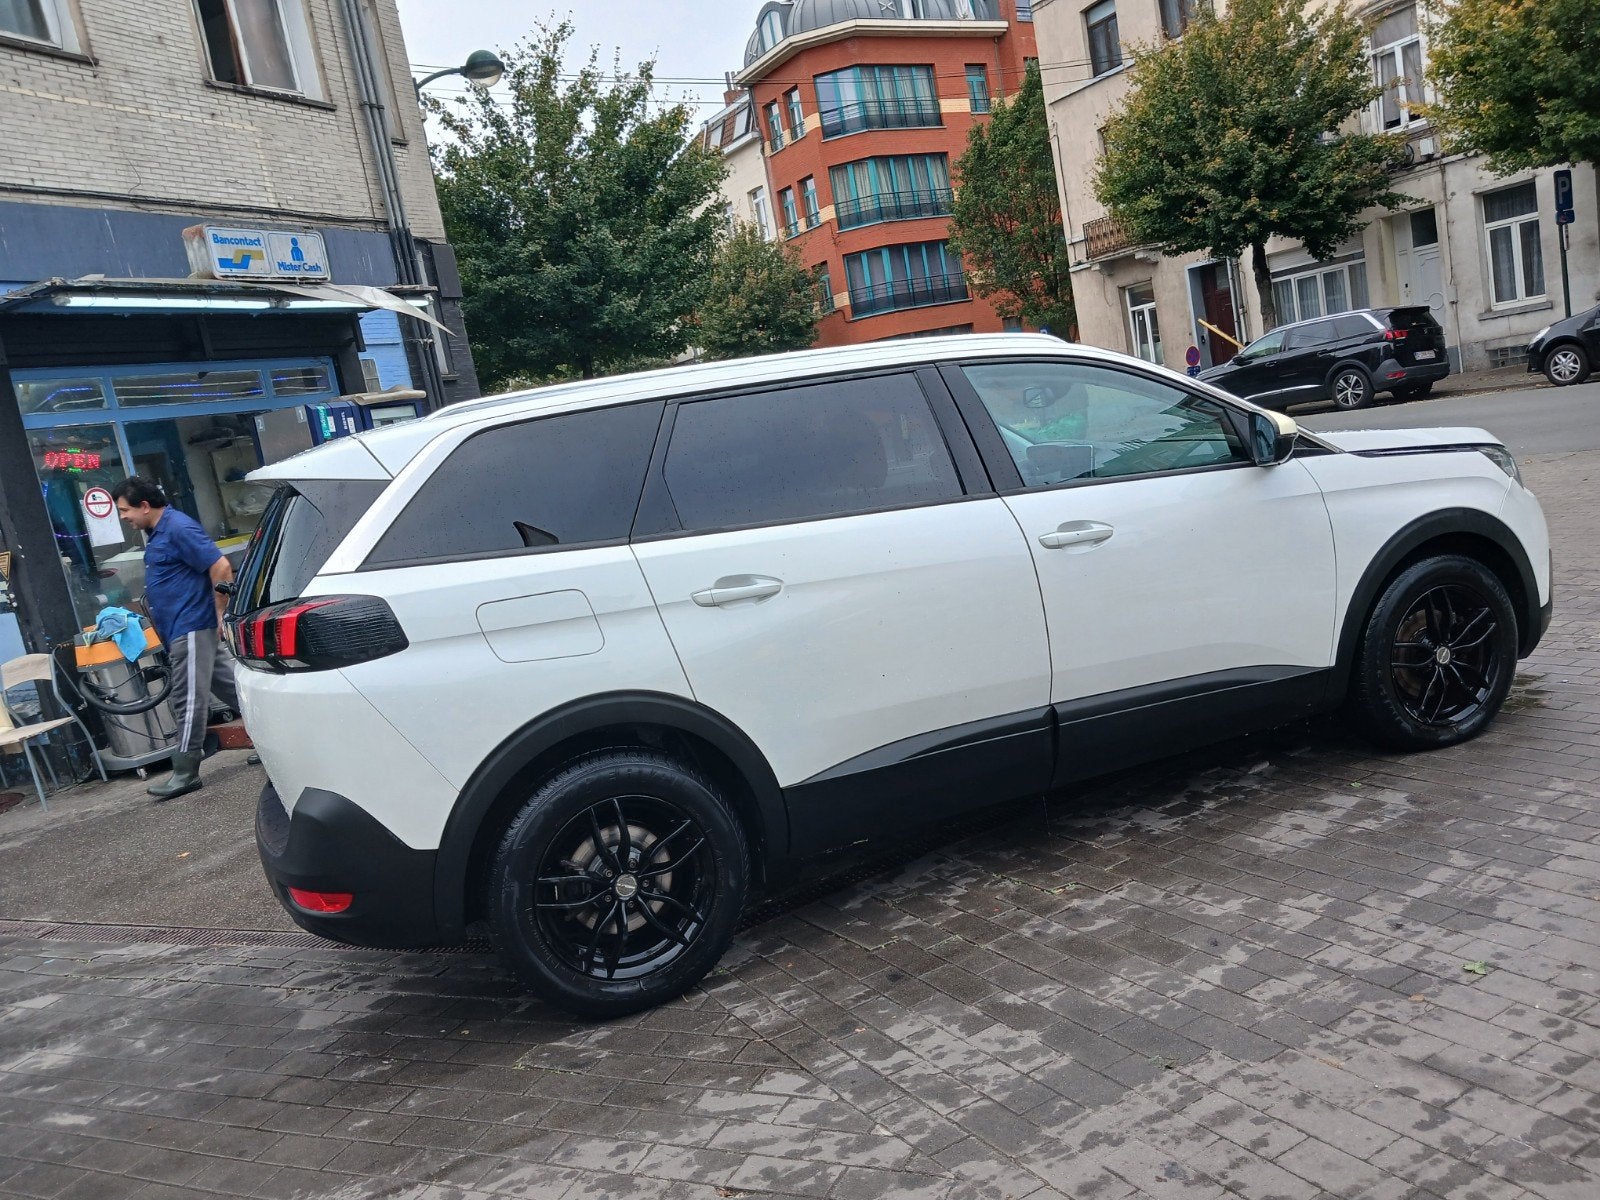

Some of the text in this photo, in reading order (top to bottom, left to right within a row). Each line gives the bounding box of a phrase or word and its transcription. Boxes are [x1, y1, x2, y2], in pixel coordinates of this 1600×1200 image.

[1557, 177, 1570, 204] P
[212, 233, 262, 247] Bancontact
[277, 261, 322, 272] Mister Cash
[44, 451, 100, 469] OPEN
